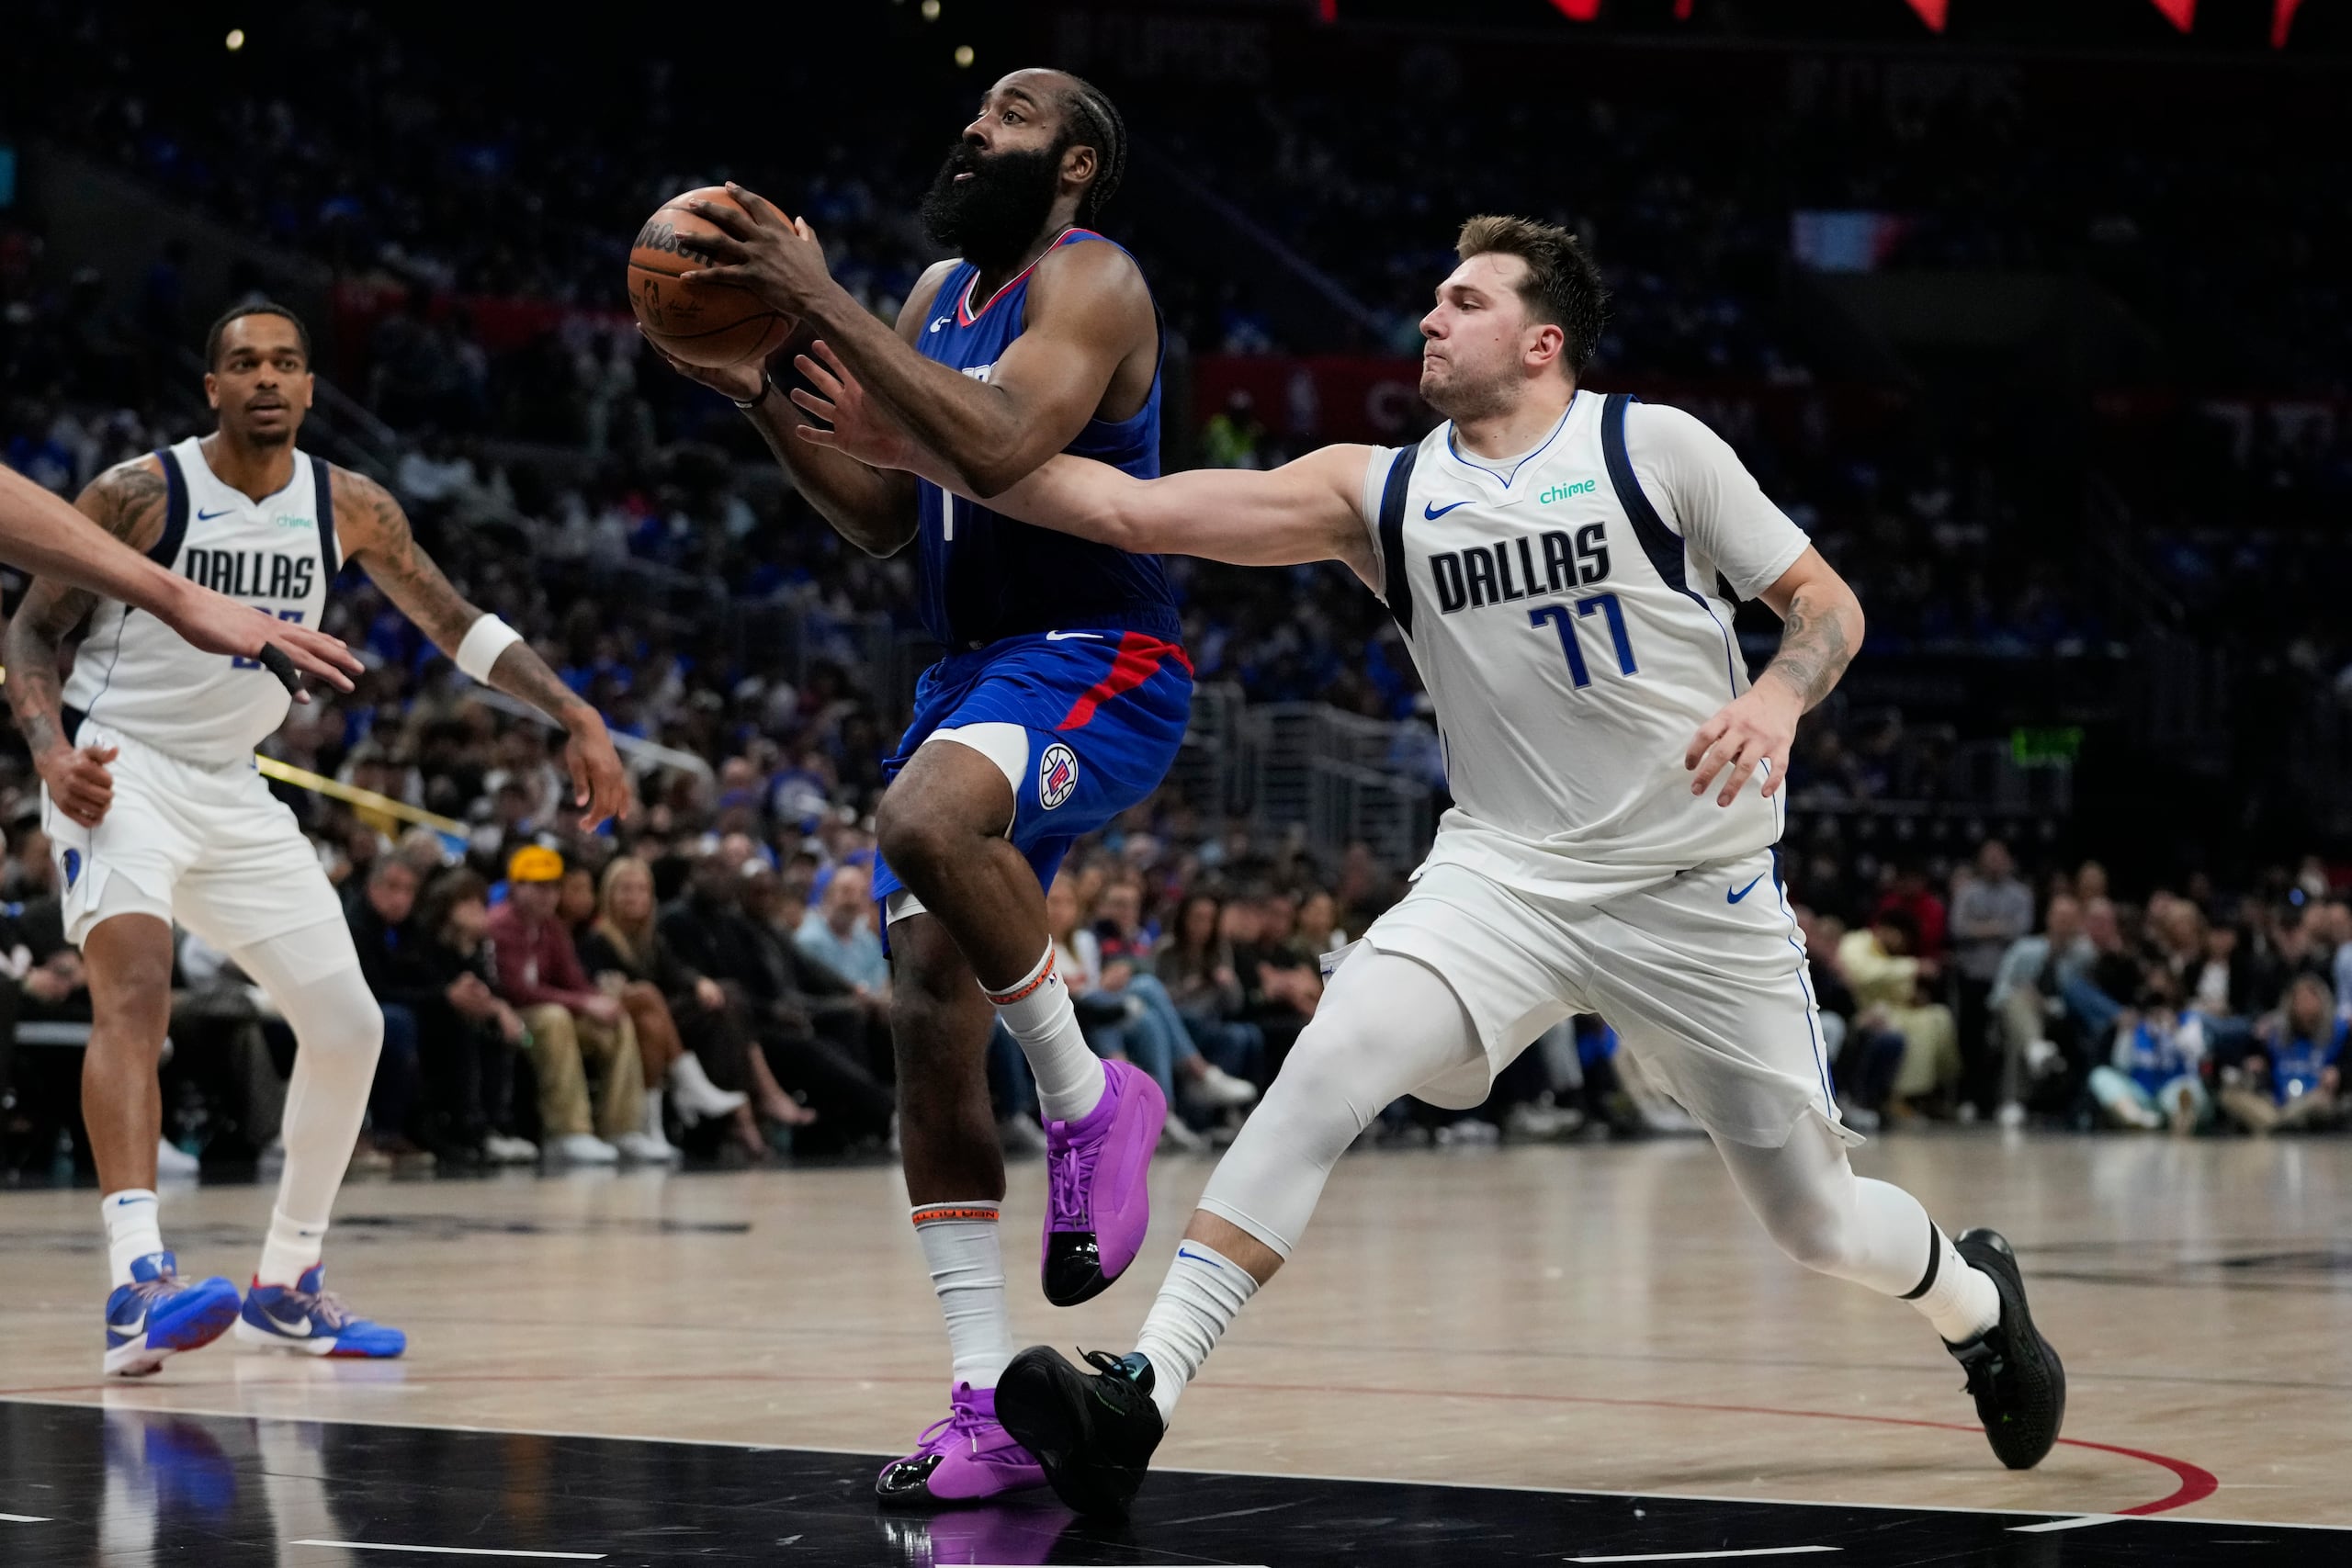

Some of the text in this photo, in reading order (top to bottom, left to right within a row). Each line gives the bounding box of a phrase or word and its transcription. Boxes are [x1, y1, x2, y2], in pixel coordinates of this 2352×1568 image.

[1540, 479, 1596, 504] chime
[277, 513, 314, 529] chime
[187, 547, 315, 599] DALLAS
[1428, 521, 1611, 615] DALLAS
[1528, 592, 1640, 691] 77
